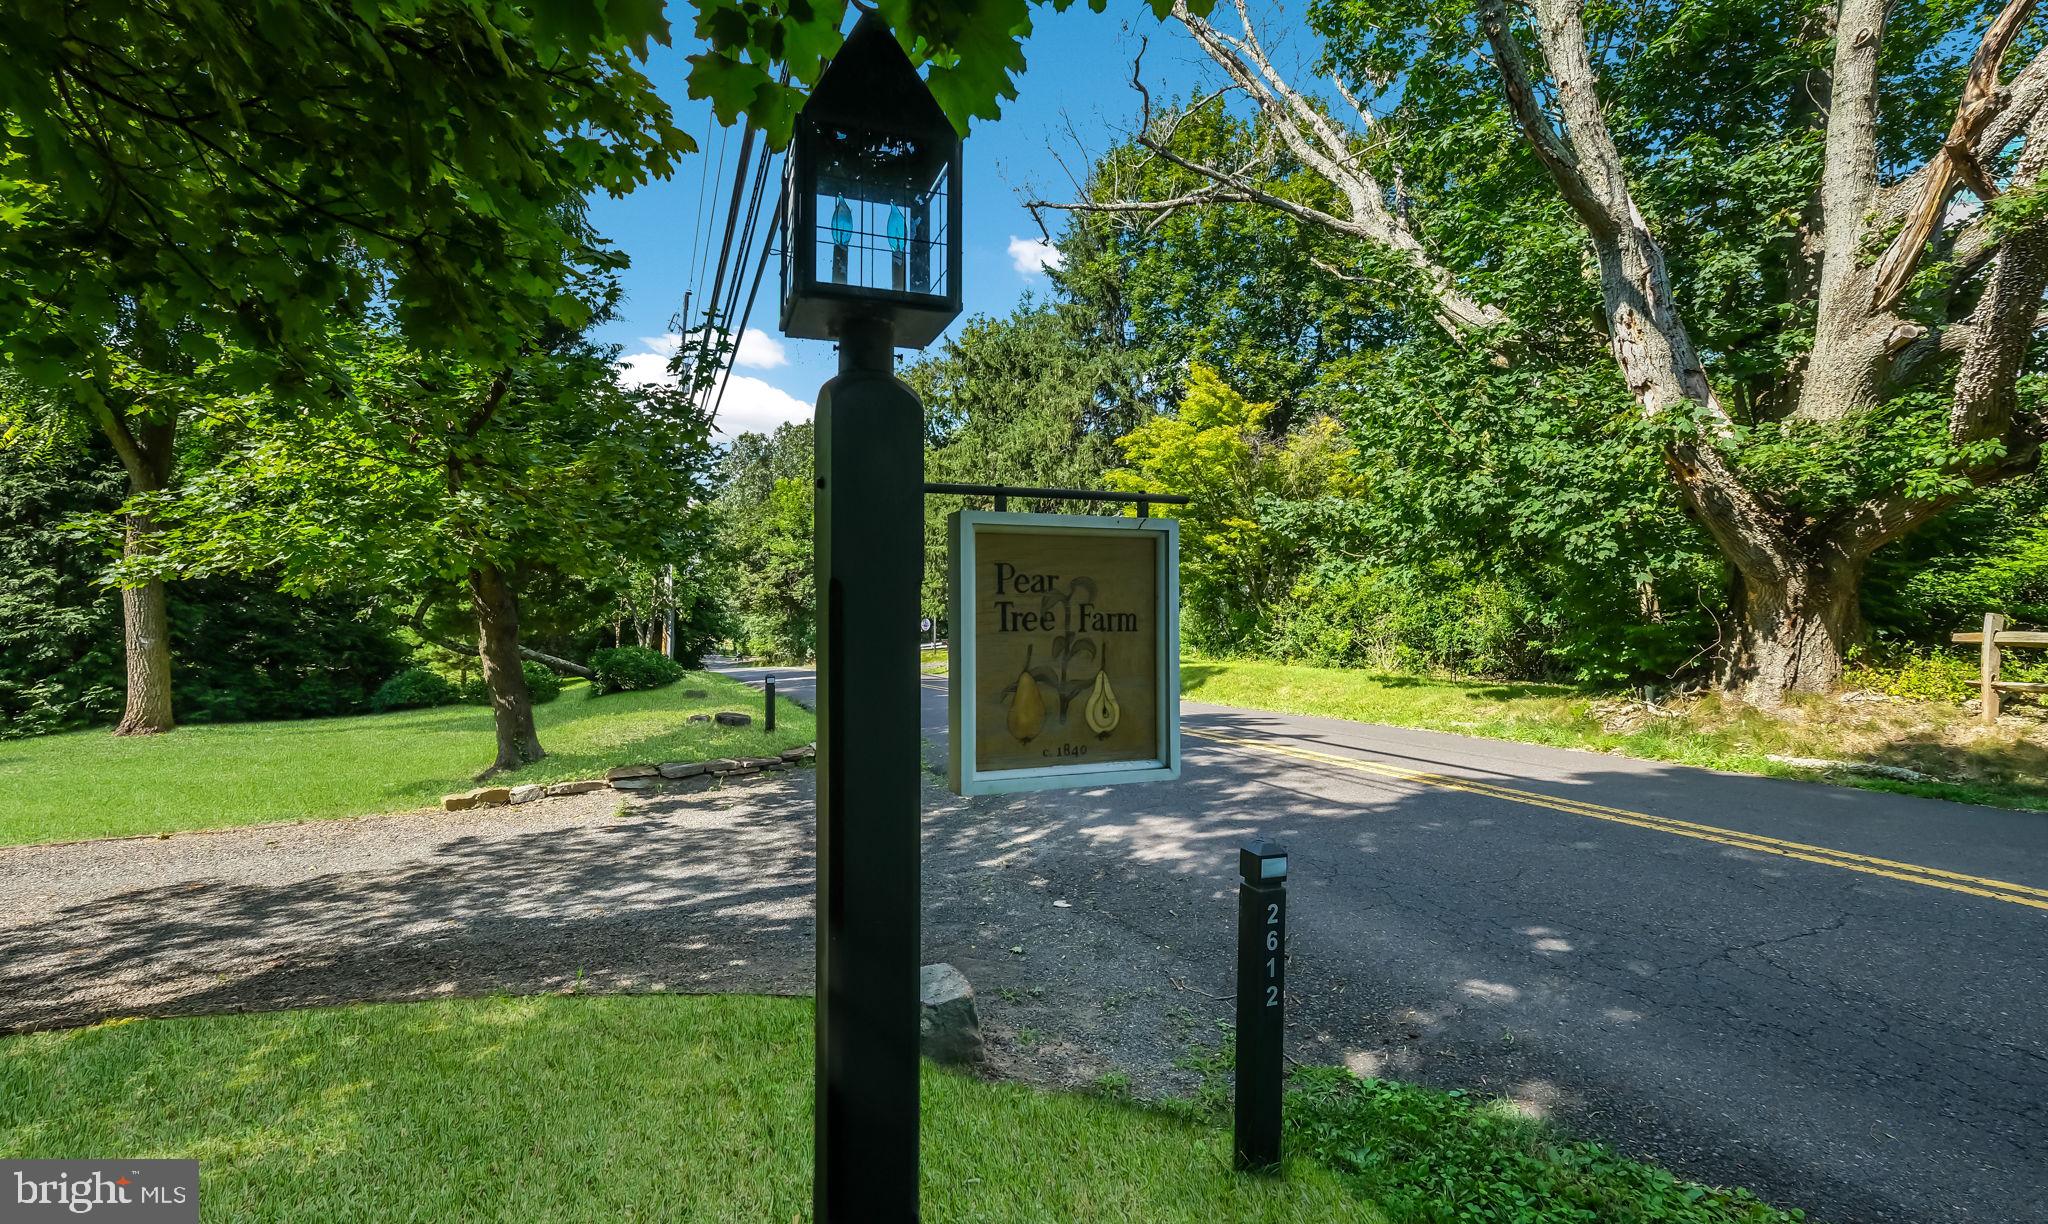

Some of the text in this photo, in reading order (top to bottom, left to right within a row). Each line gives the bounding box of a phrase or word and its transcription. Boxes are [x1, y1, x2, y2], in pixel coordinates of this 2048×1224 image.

[994, 562, 1059, 595] Pear
[994, 601, 1138, 632] Tree Farm
[1056, 743, 1088, 758] 1840
[1266, 903, 1279, 1007] 2612
